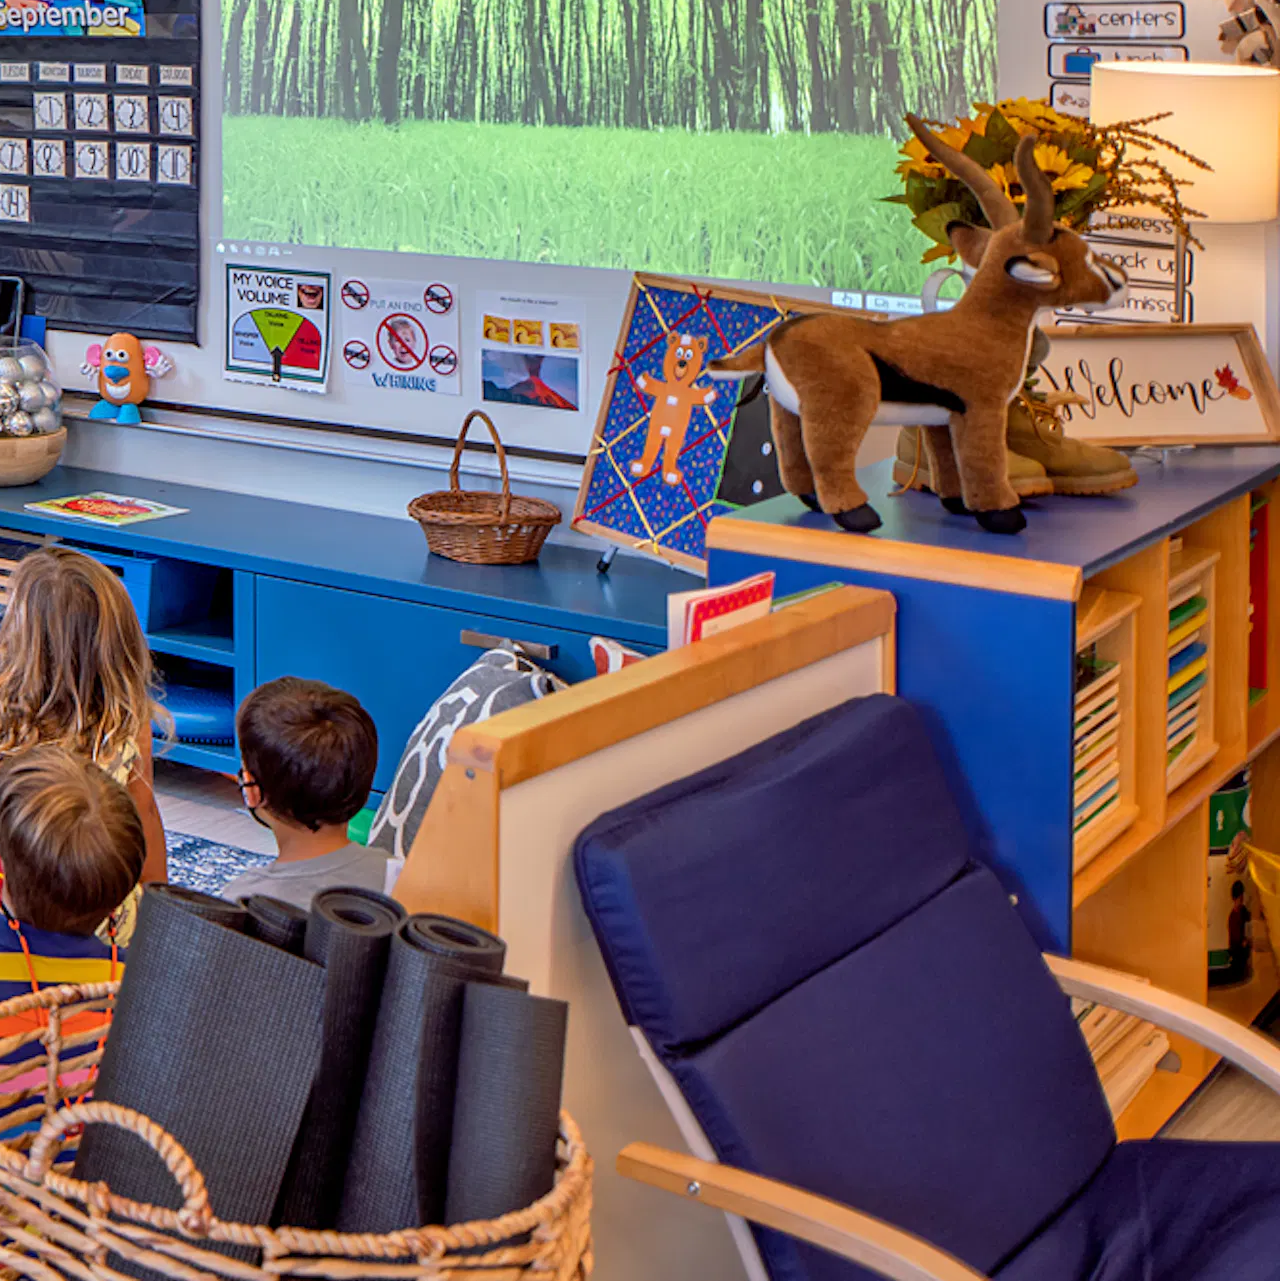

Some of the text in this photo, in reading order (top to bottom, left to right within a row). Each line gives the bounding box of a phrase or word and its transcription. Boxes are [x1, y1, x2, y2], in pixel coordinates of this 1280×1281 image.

[1097, 11, 1176, 27] centers
[85, 99, 96, 125] 2
[170, 101, 182, 130] 4
[7, 143, 16, 169] 7
[88, 146, 97, 171] 9
[233, 273, 294, 290] MY VOICE
[238, 289, 290, 306] VOLUME
[403, 302, 422, 312] END
[372, 372, 437, 393] WHINING
[1039, 357, 1226, 421] Welcome
